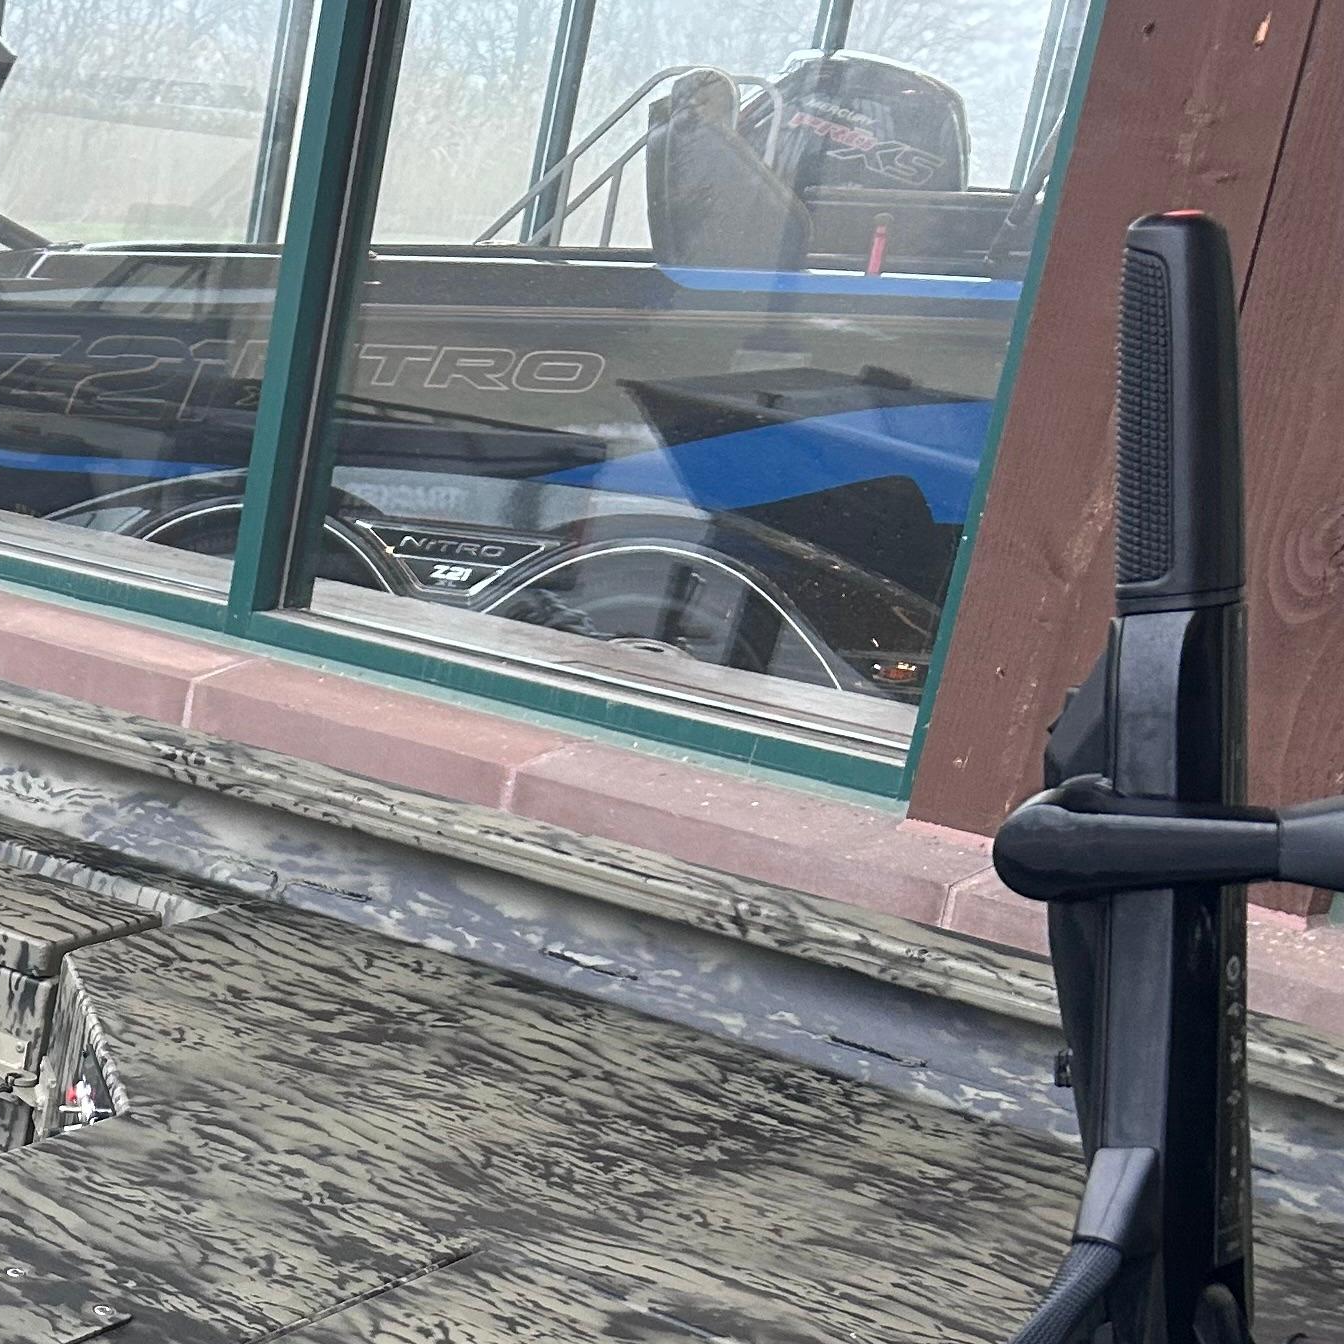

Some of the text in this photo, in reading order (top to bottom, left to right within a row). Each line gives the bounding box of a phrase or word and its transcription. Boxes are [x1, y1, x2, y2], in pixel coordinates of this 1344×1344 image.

[826, 140, 947, 186] XS
[398, 535, 506, 558] NITRO
[429, 563, 474, 582] Z21
